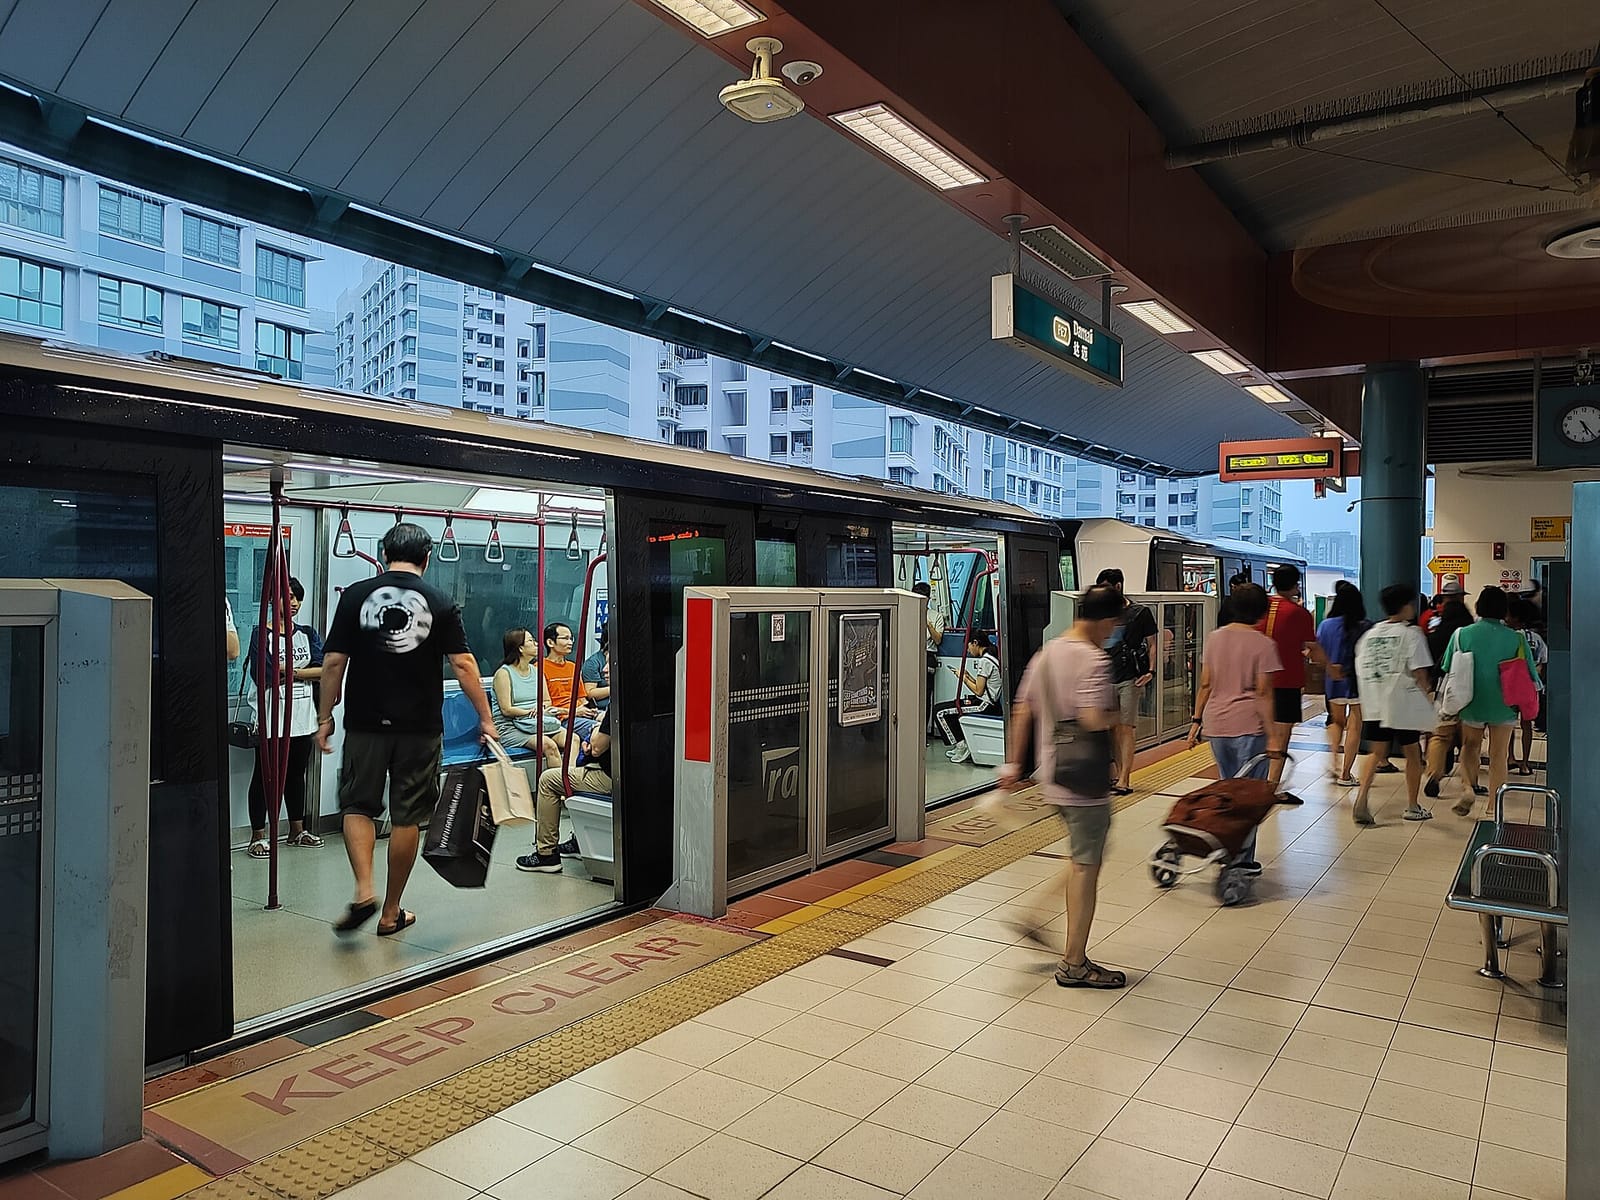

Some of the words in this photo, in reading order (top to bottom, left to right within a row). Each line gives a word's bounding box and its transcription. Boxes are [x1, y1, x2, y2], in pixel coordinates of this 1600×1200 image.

[1073, 320, 1094, 345] Damai
[241, 1016, 475, 1116] KEEP
[491, 936, 704, 1016] CLEAR
